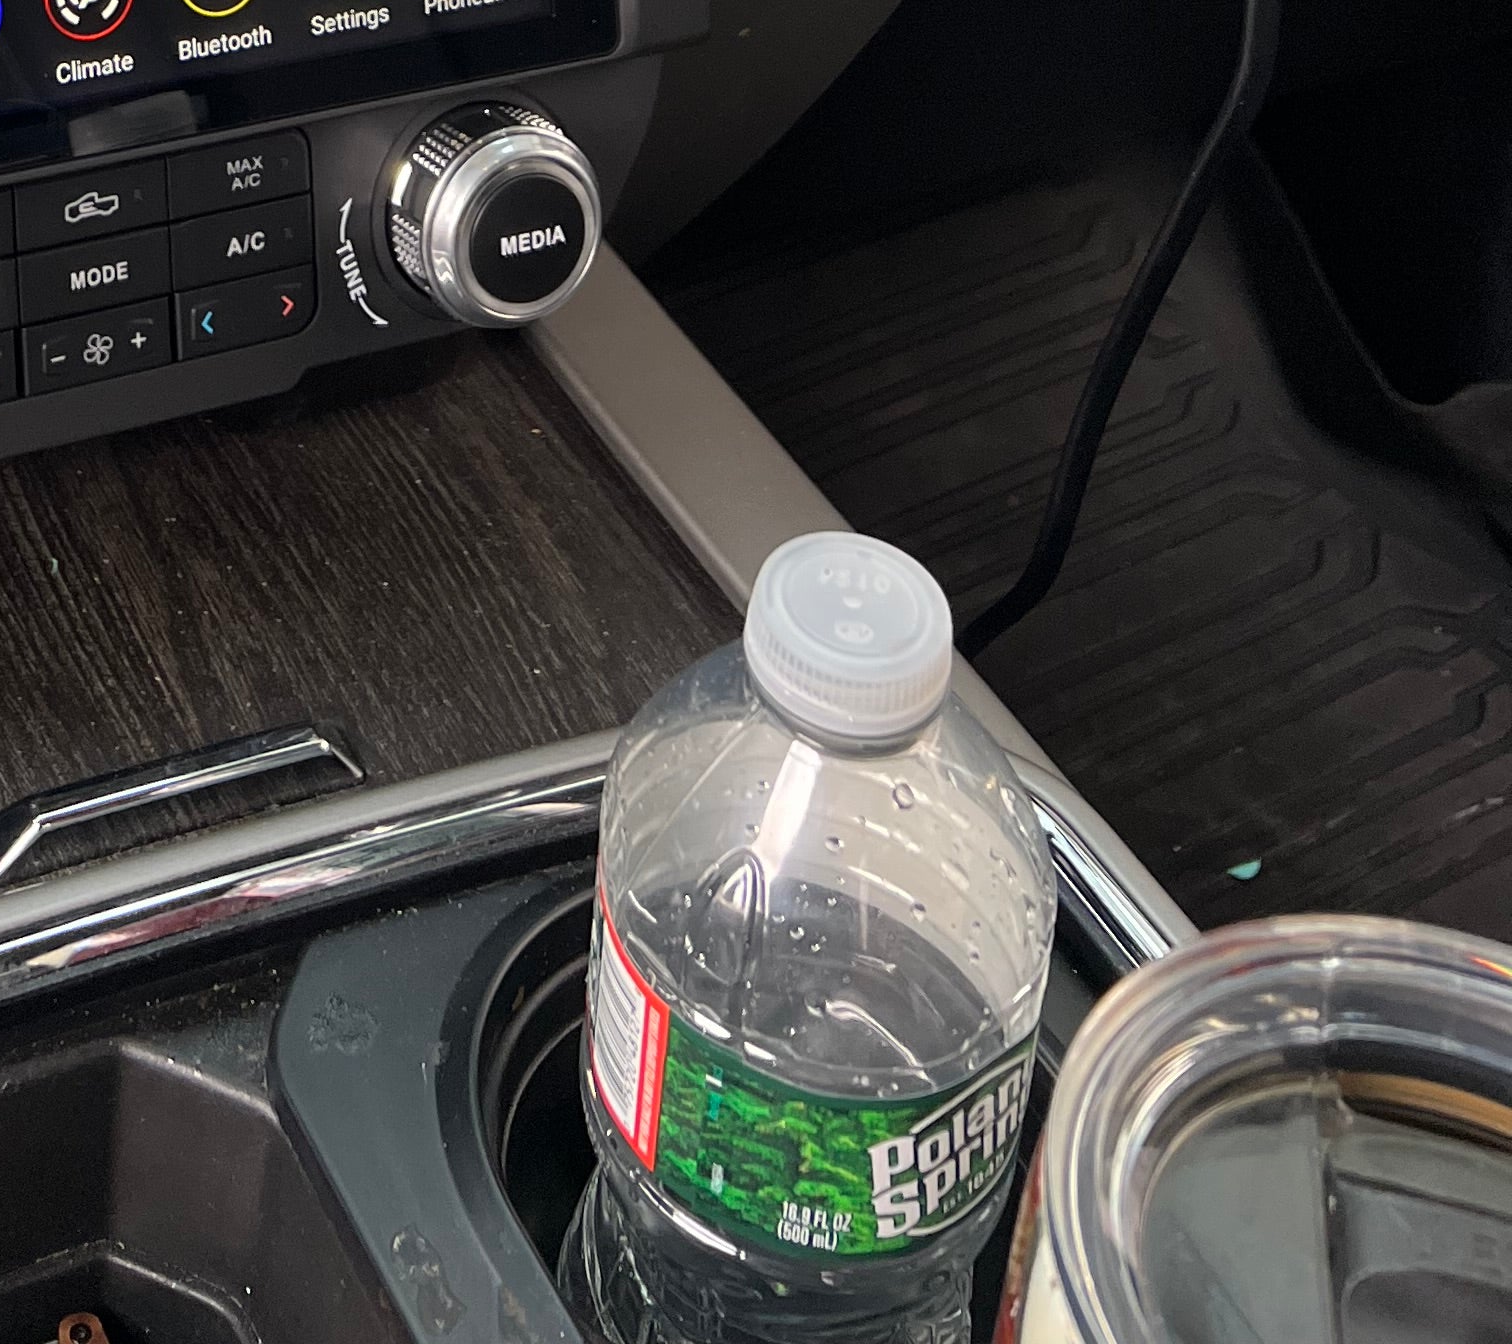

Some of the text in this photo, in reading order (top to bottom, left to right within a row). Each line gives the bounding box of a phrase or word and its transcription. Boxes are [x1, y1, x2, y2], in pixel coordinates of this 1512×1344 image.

[310, 4, 390, 37] Settings
[177, 25, 273, 61] Bluetooth
[54, 52, 135, 85] Climate
[226, 154, 264, 178] MAX
[230, 170, 262, 192] A/C
[226, 230, 267, 258] A/C
[499, 224, 567, 258] MEDIA
[70, 260, 130, 291] MODE
[335, 240, 369, 303] TUNE
[871, 1097, 1028, 1239] Sprin
[782, 1200, 853, 1233] 16.9 FL OZ
[777, 1217, 838, 1253] (500 mL)
